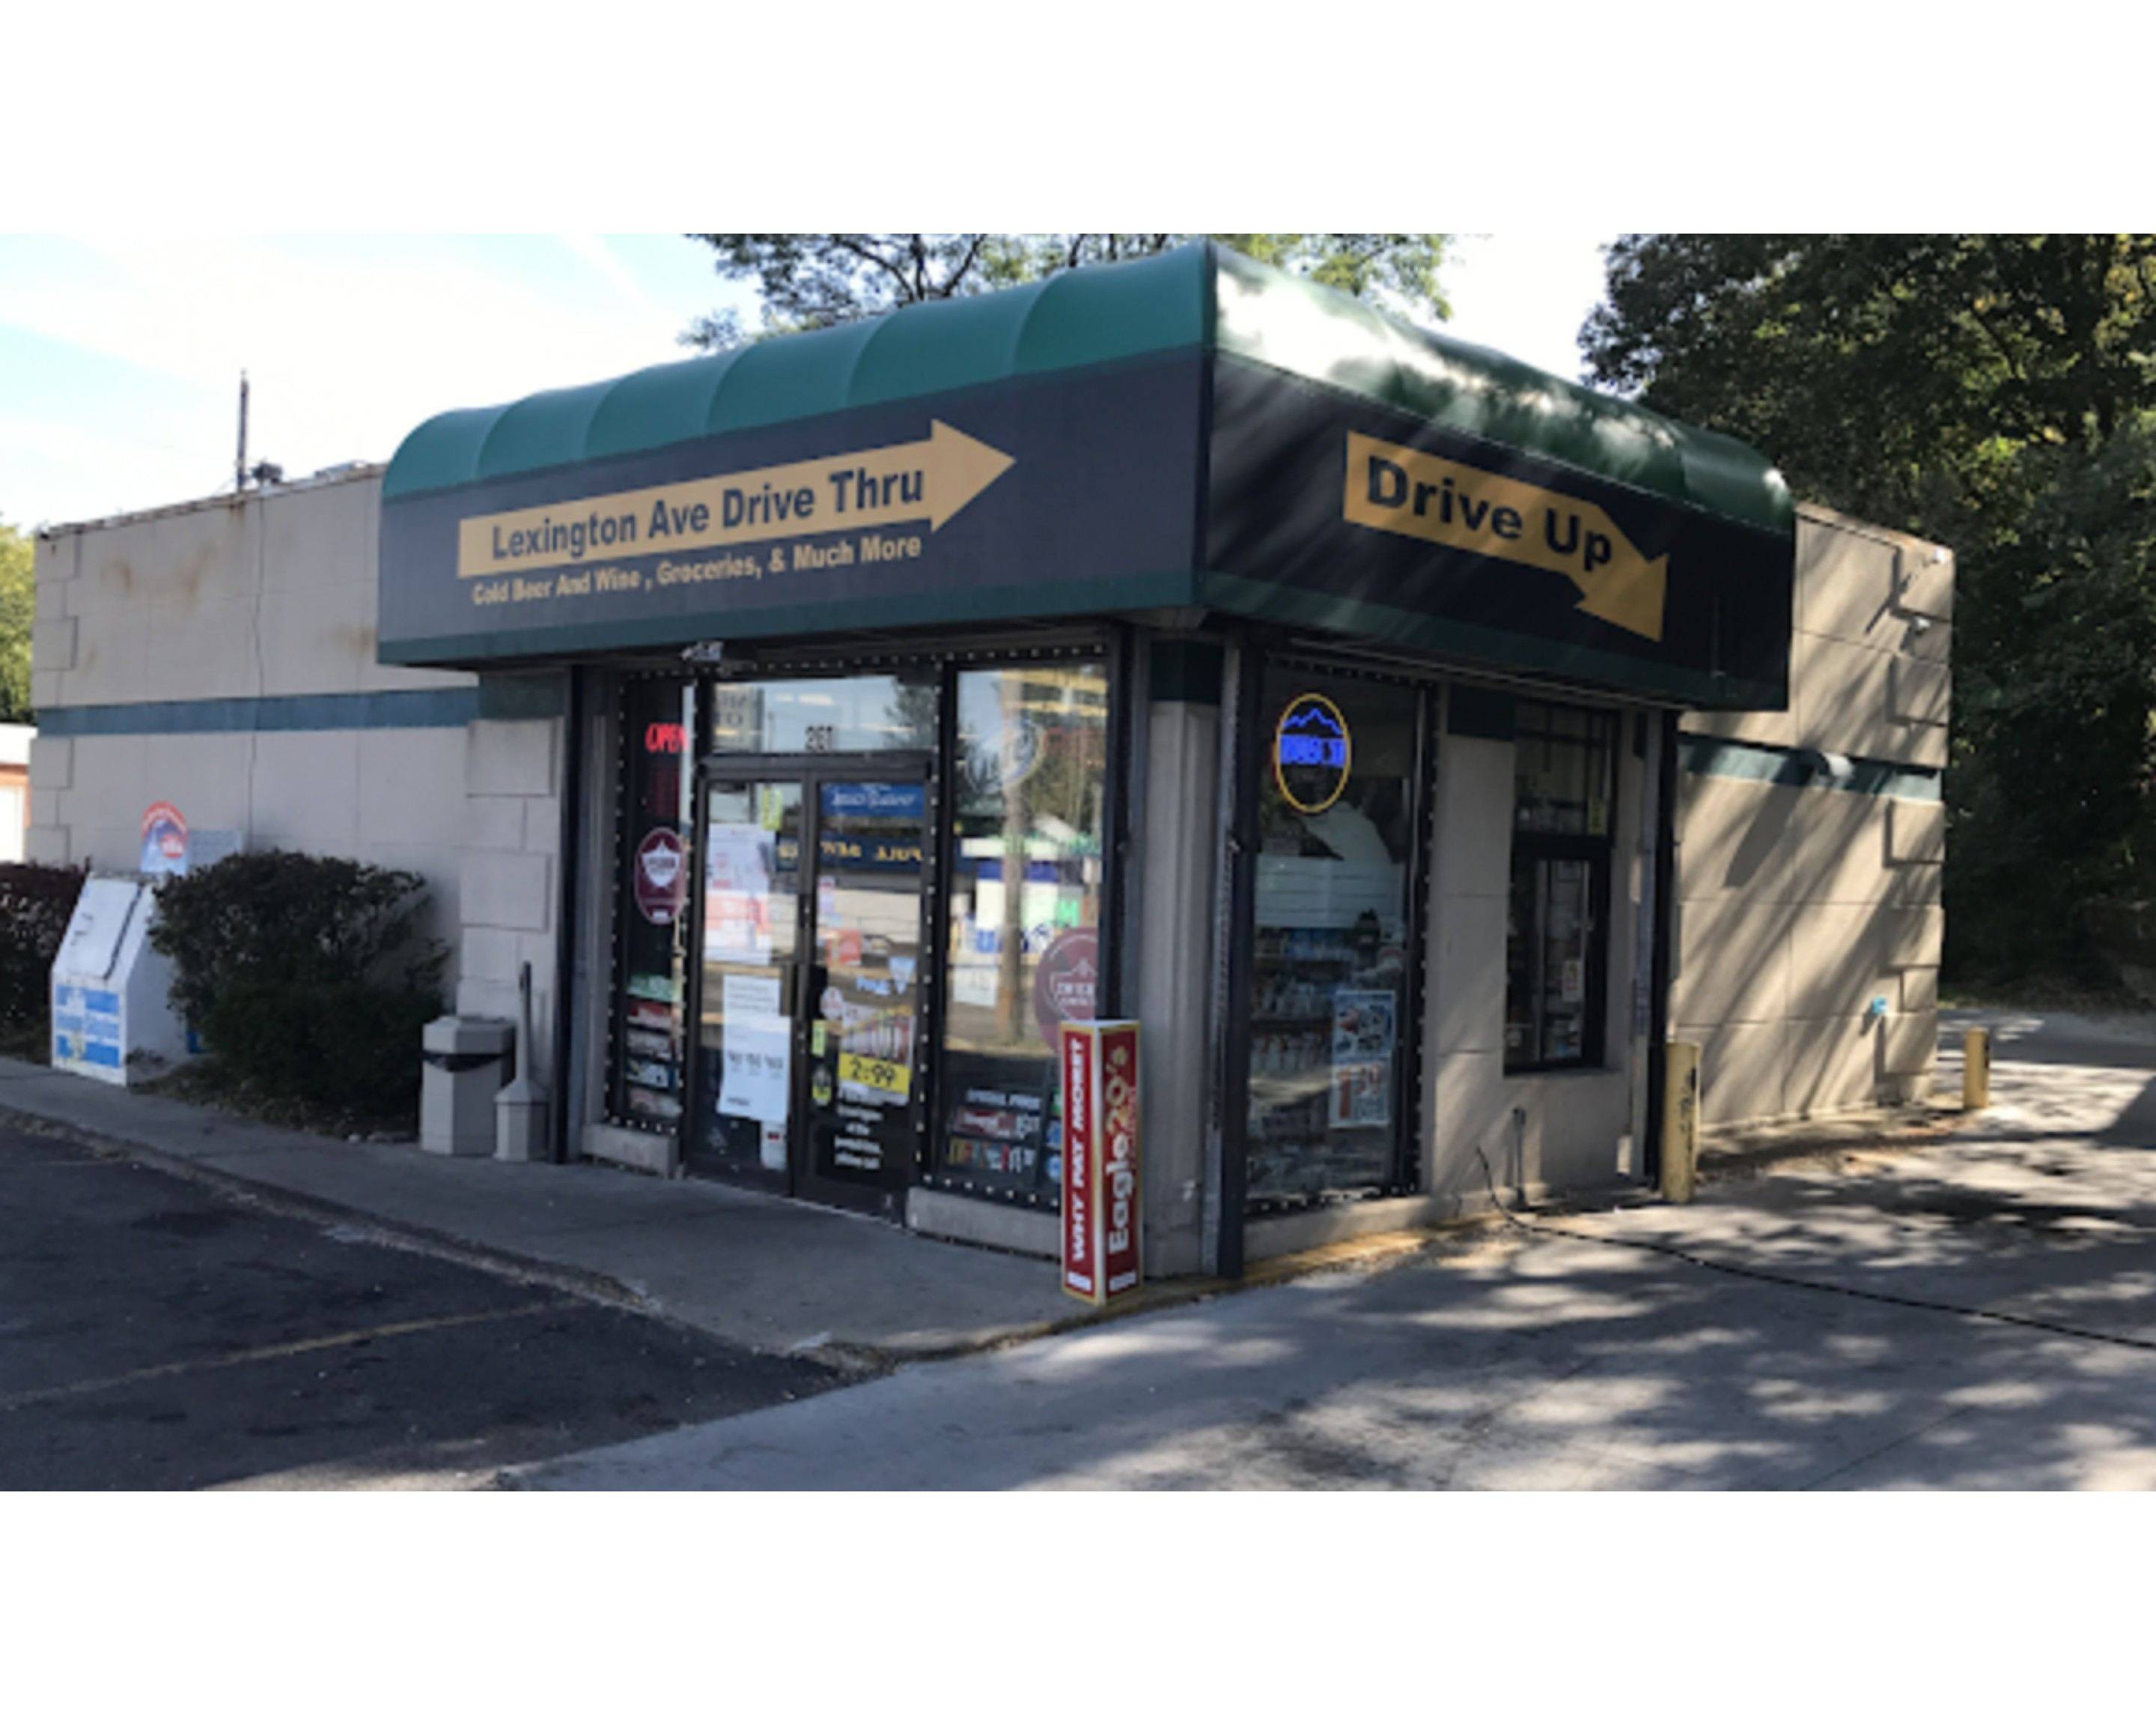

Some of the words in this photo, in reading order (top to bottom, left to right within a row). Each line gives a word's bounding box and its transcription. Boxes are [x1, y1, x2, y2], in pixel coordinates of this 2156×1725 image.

[492, 514, 636, 559] Lexington
[648, 499, 710, 538] Ave
[722, 483, 814, 529] Drive
[829, 467, 925, 513] Thru
[1367, 455, 1523, 540] Drive
[1544, 508, 1612, 572] Up
[472, 580, 510, 606] Cold
[512, 577, 552, 602] Beer
[555, 571, 591, 596] And
[656, 552, 762, 586] Groceries,
[768, 547, 785, 573] &
[792, 538, 854, 571] Much
[860, 535, 922, 563] More
[1071, 1135, 1085, 1189] PAY
[1106, 1132, 1135, 1253] Eagle
[1071, 1193, 1085, 1262] WHY
